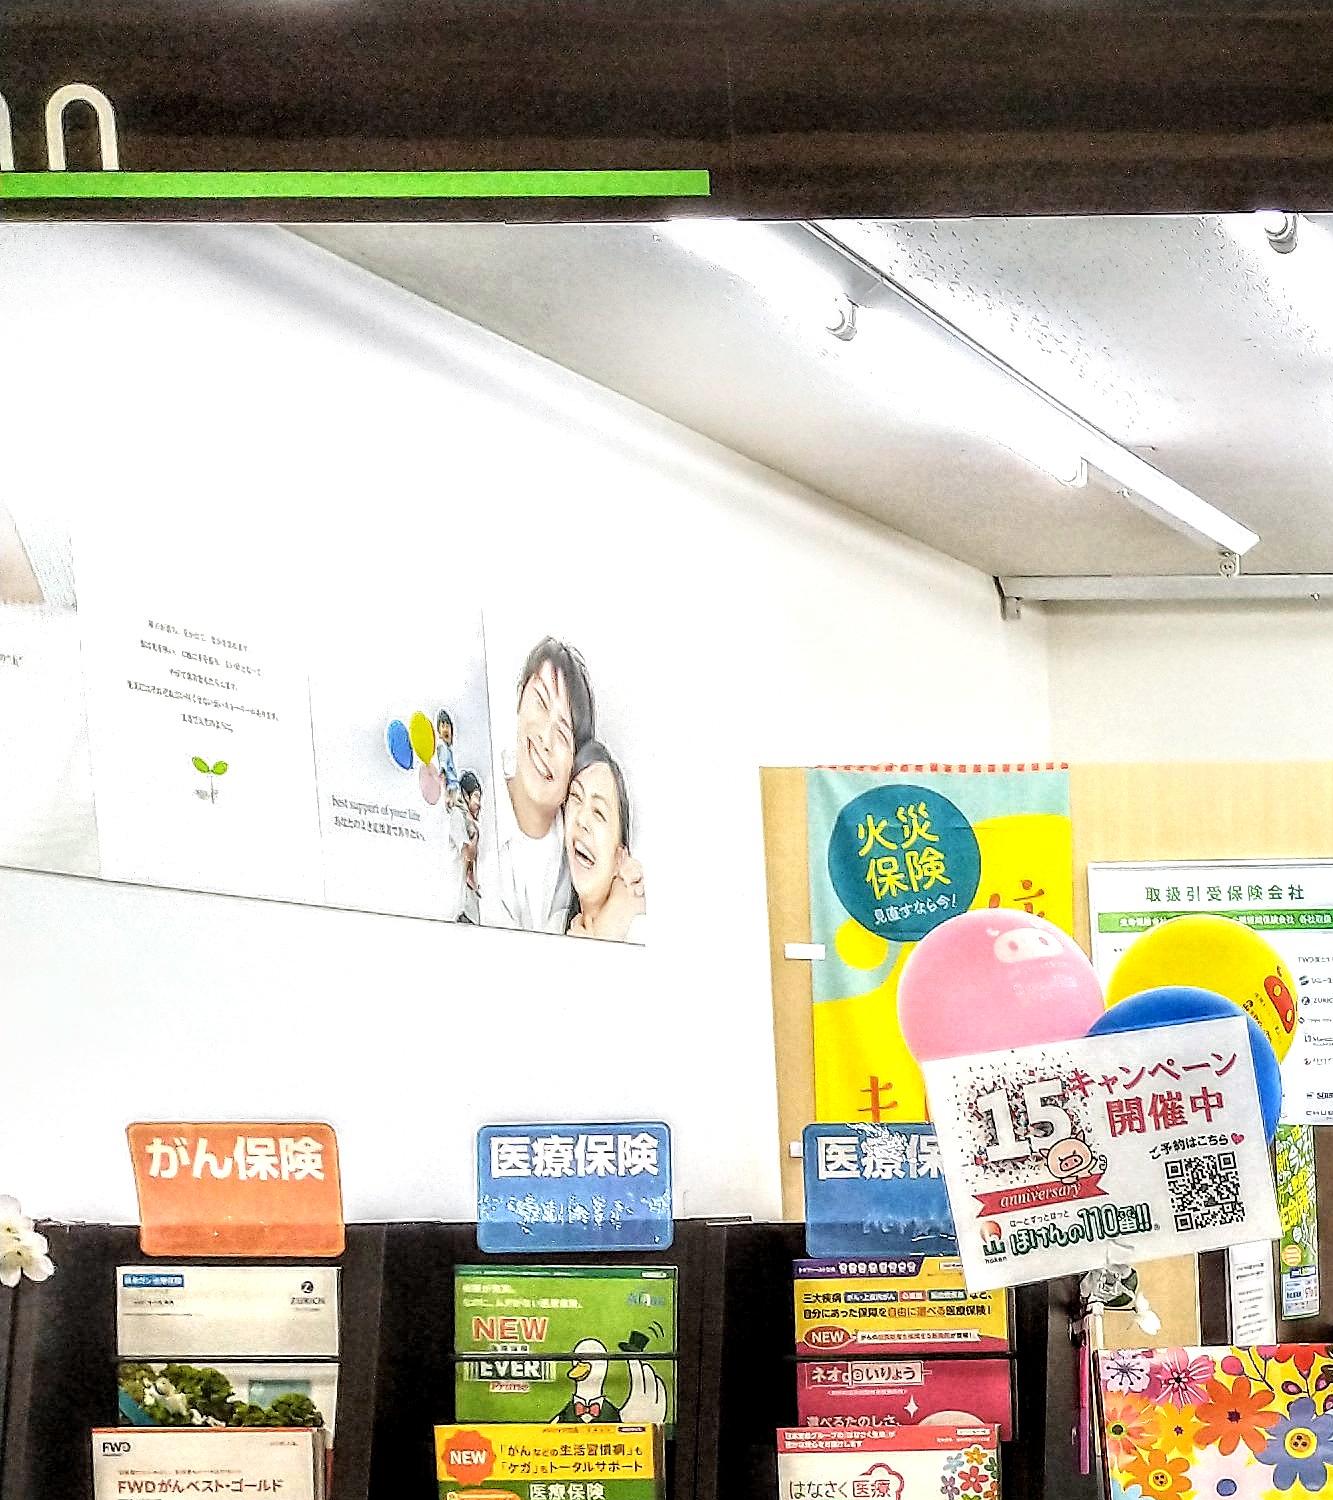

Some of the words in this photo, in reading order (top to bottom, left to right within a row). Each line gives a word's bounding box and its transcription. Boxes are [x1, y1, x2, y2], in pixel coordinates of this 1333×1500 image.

[856, 800, 941, 853] 火災
[865, 846, 952, 901] 保険
[1145, 883, 1305, 903] 取扱引受保険会社
[874, 892, 958, 926] 見直すなら今!
[973, 1075, 1074, 1167] 15
[1065, 1051, 1238, 1099] キャンペーン
[1105, 1085, 1226, 1138] 開催中
[146, 1135, 326, 1183] がん保険
[488, 1133, 660, 1180] 医療保険
[1148, 1133, 1230, 1160] ご予約はこちら
[1000, 1182, 1082, 1209] anniversary
[984, 1254, 1008, 1265] hoken
[473, 1316, 549, 1343] NEW
[810, 1331, 845, 1344] NEW
[479, 1360, 543, 1380] EVER
[102, 1441, 132, 1454] FWD
[450, 1450, 487, 1465] NEW
[117, 1478, 284, 1495] FWDがんベスト・ゴールド
[529, 1483, 605, 1500] 医療保険
[789, 1479, 892, 1500] はなさく医療
